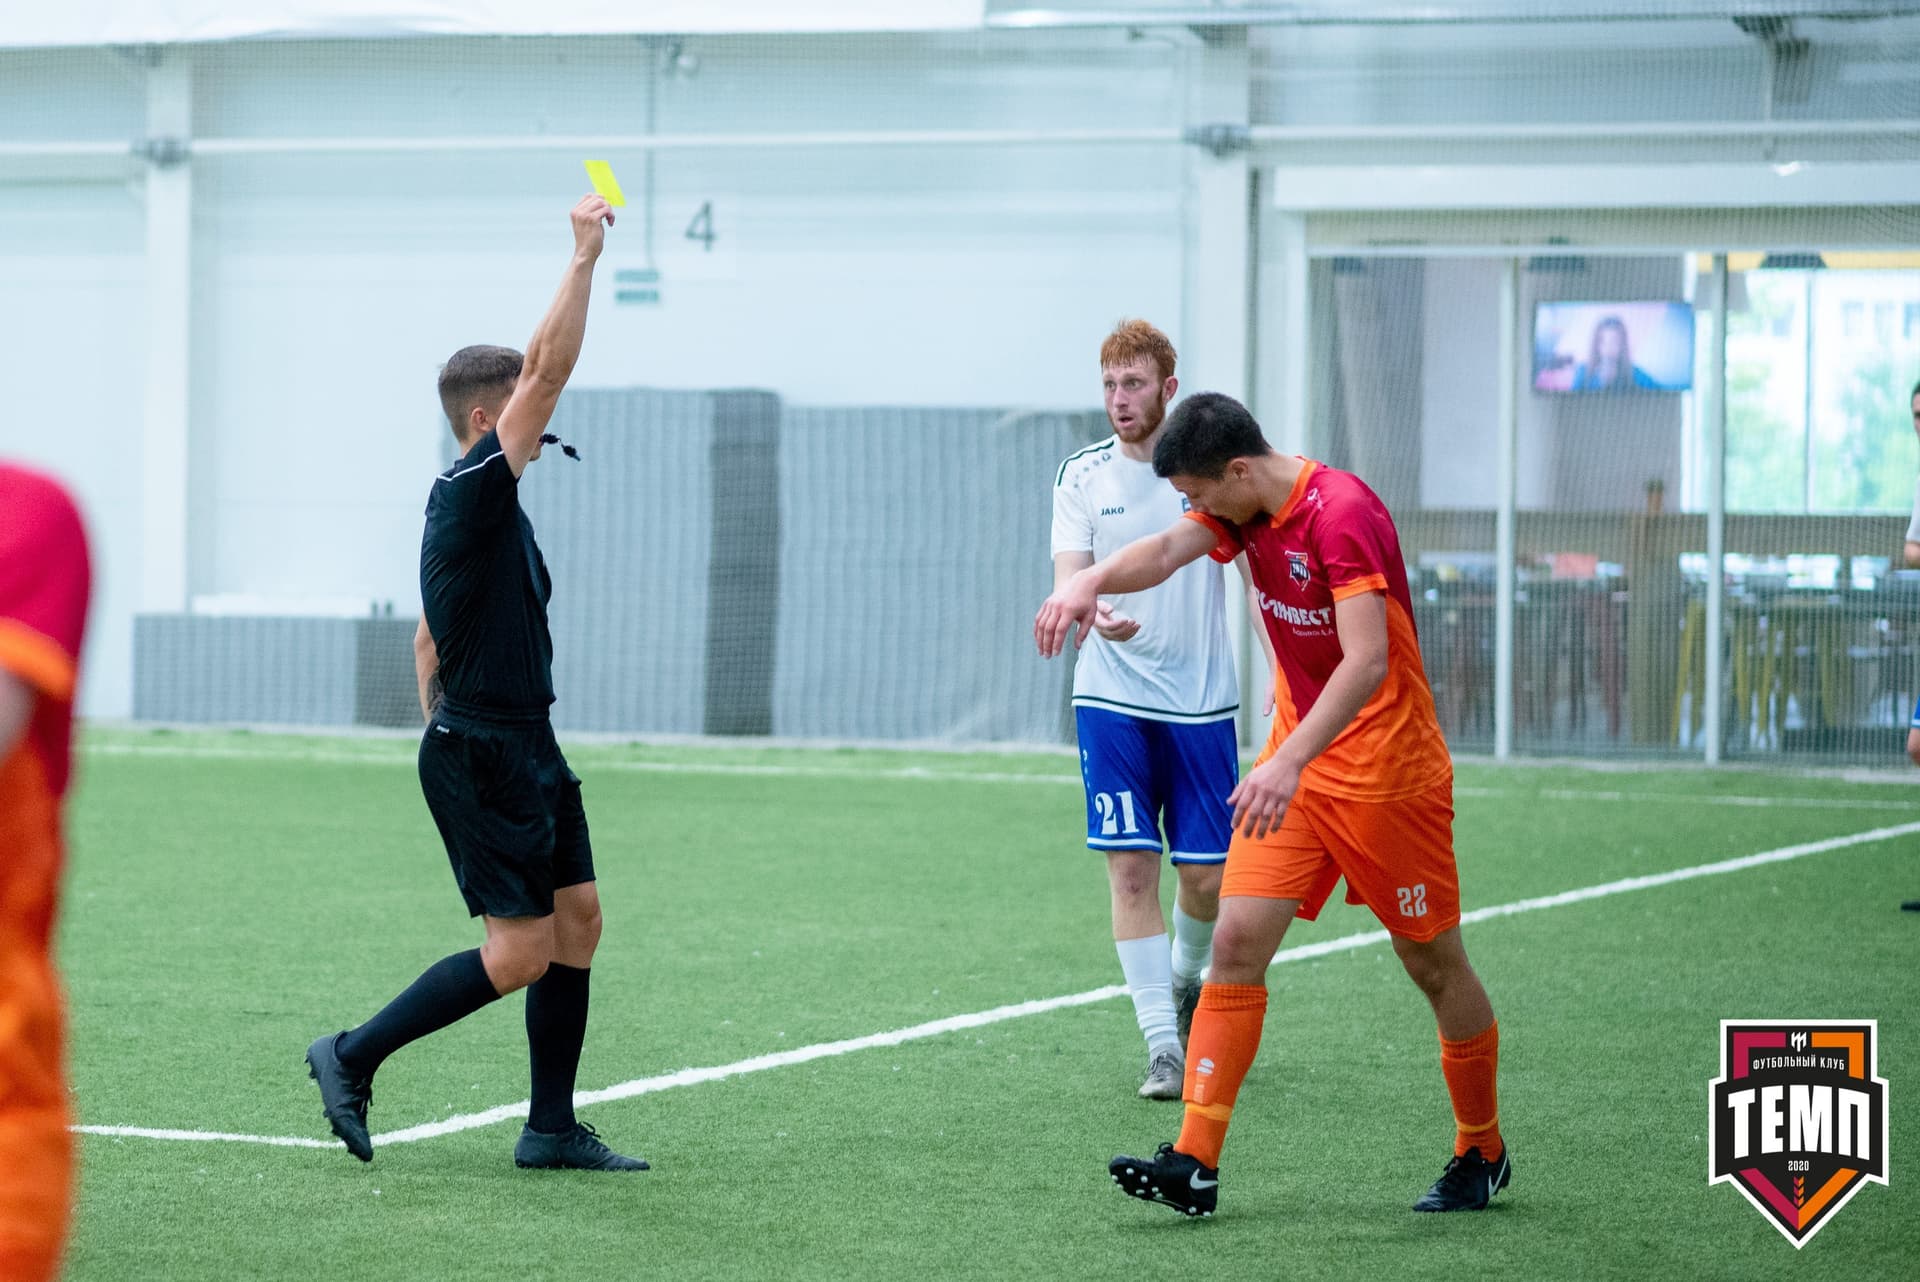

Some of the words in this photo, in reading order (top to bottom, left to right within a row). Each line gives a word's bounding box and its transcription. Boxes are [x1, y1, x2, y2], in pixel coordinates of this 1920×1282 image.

[684, 201, 717, 251] 4
[1100, 506, 1125, 516] JAKO
[1095, 790, 1140, 835] 21
[1396, 883, 1428, 917] 22
